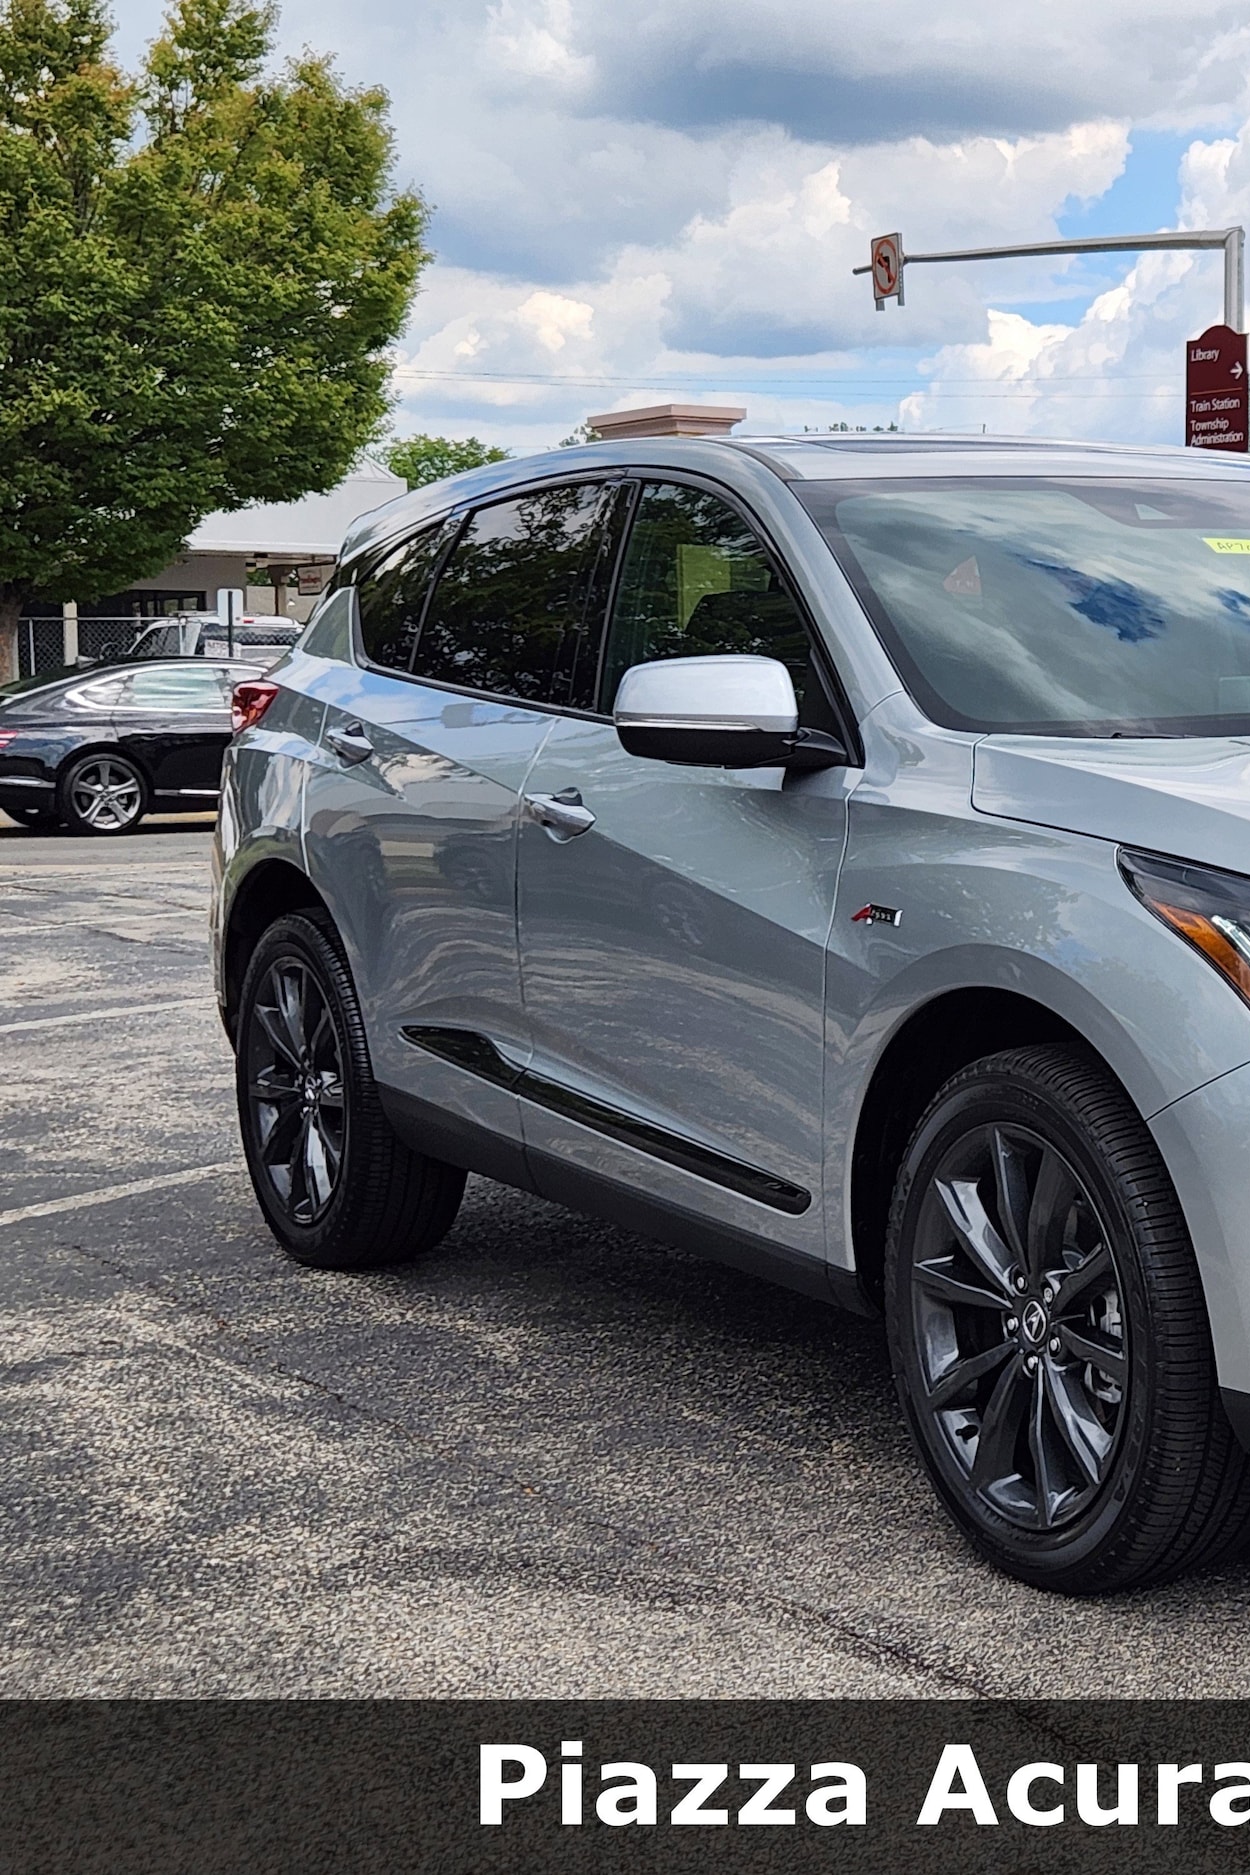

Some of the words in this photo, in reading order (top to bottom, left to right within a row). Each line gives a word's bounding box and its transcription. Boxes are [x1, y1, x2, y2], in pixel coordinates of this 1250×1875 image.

[1190, 348, 1219, 362] Library
[1190, 400, 1211, 412] Train
[1212, 397, 1240, 411] Station
[1190, 418, 1229, 432] Township
[1190, 431, 1243, 447] Administration
